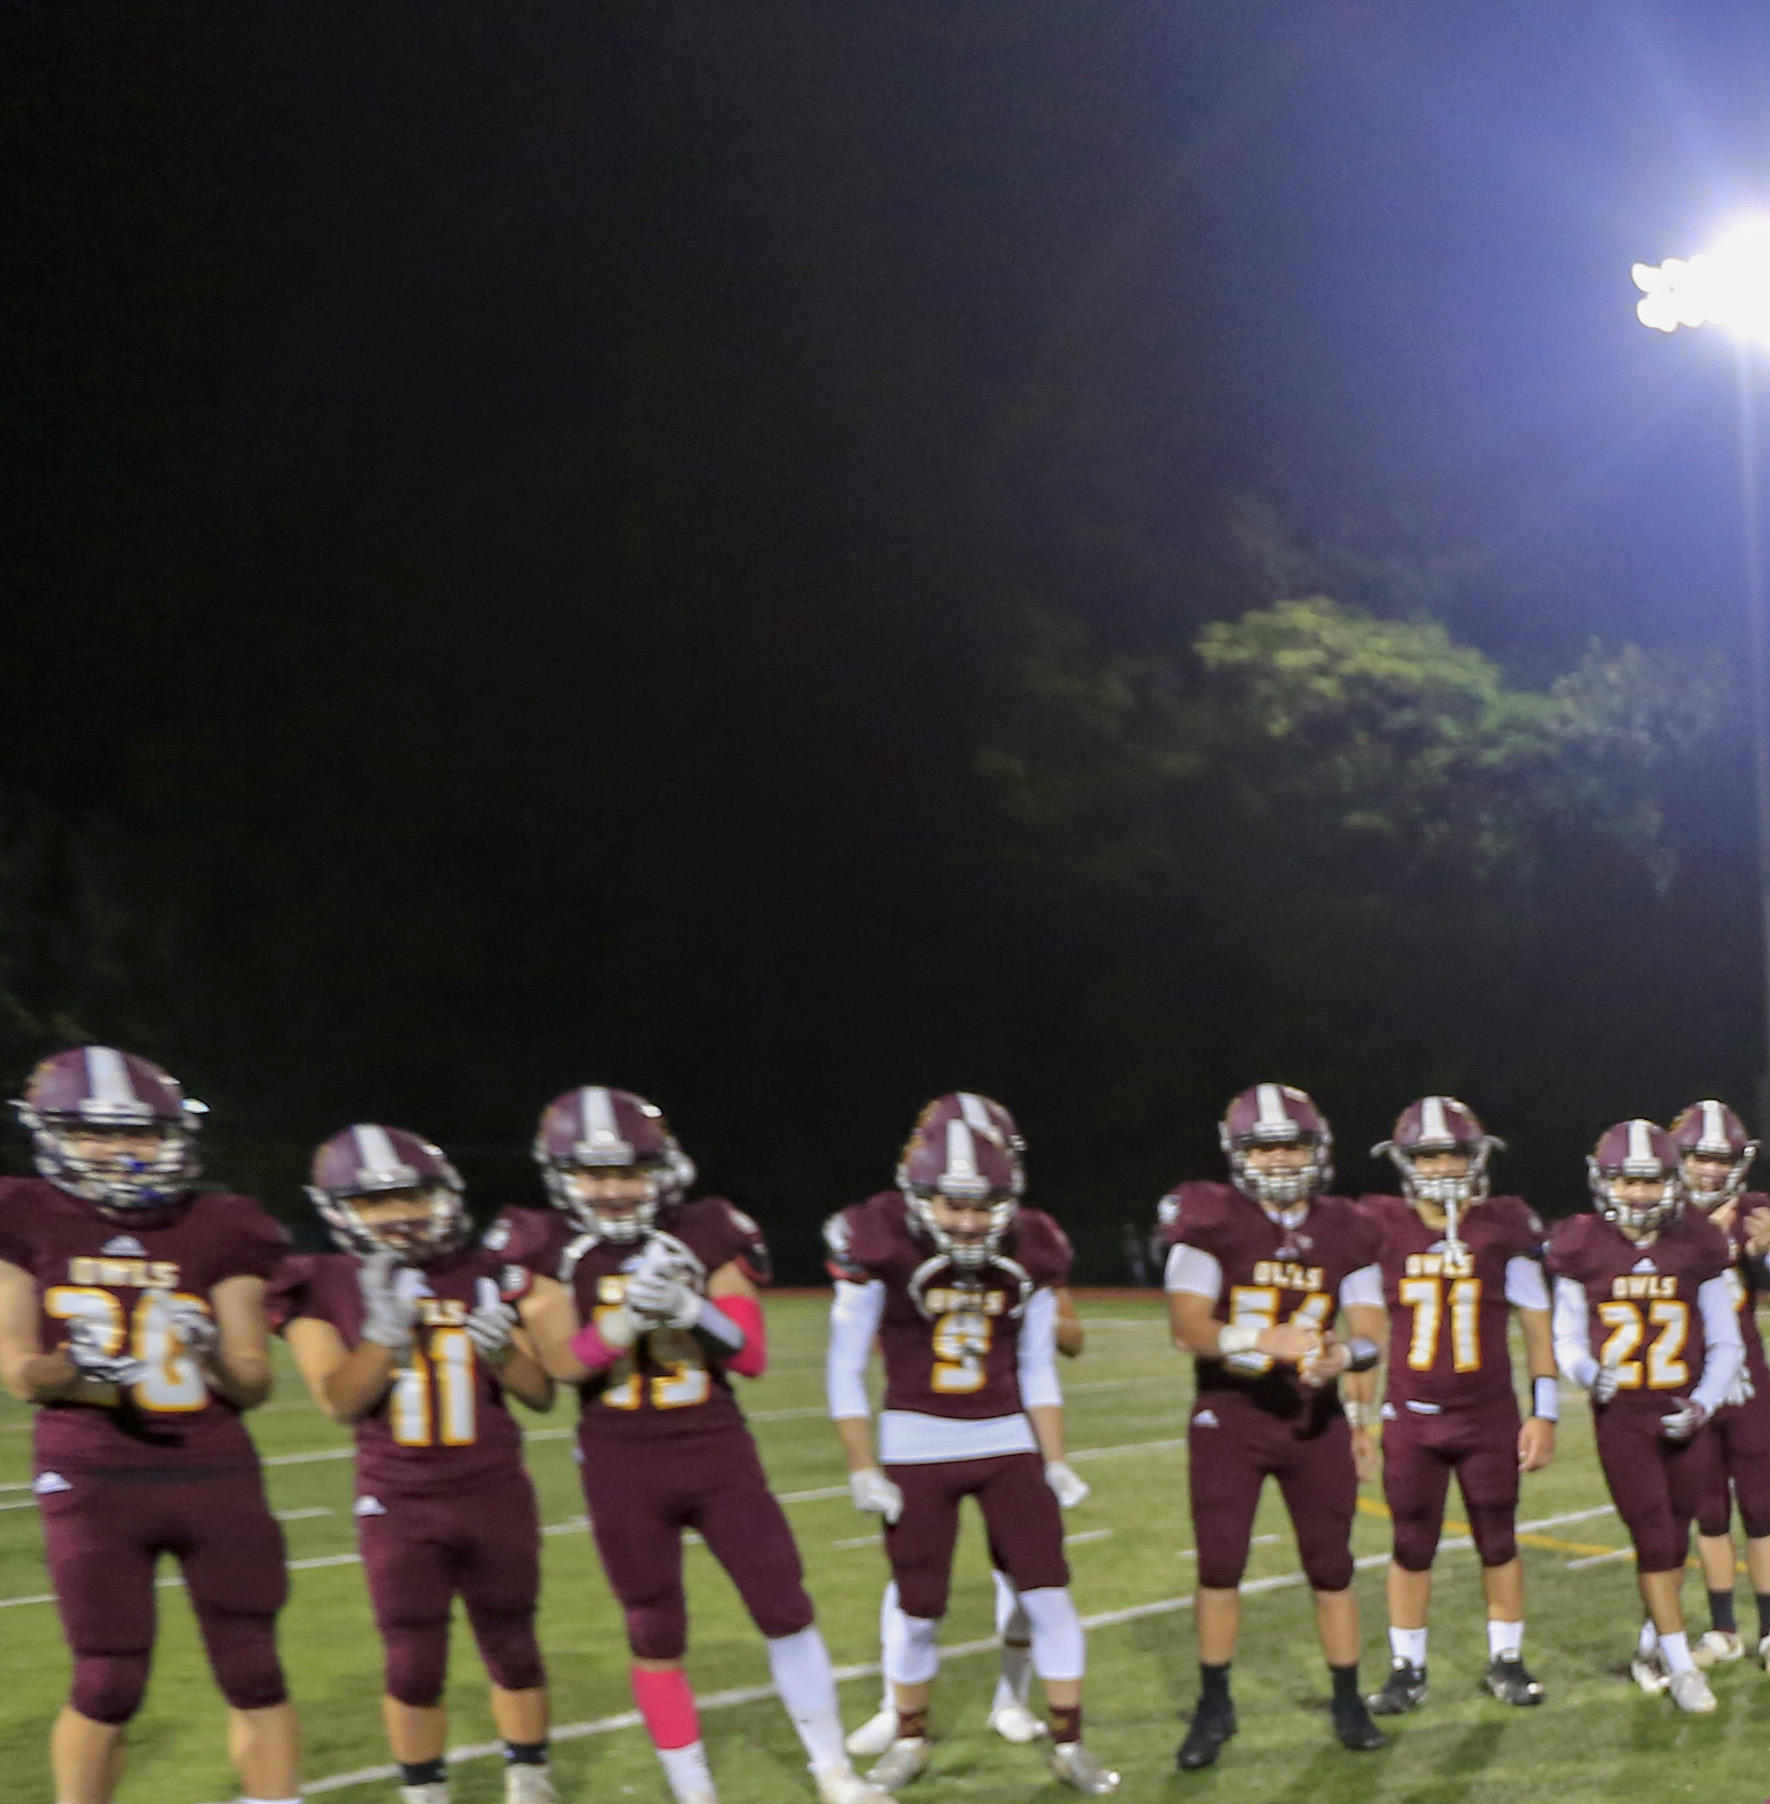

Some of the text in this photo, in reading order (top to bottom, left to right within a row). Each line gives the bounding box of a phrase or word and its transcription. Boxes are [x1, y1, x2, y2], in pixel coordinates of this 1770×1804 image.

[68, 1255, 182, 1290] OWLS
[1610, 1275, 1679, 1300] OWLS
[1398, 1276, 1483, 1374] 71
[1596, 1299, 1691, 1391] 22
